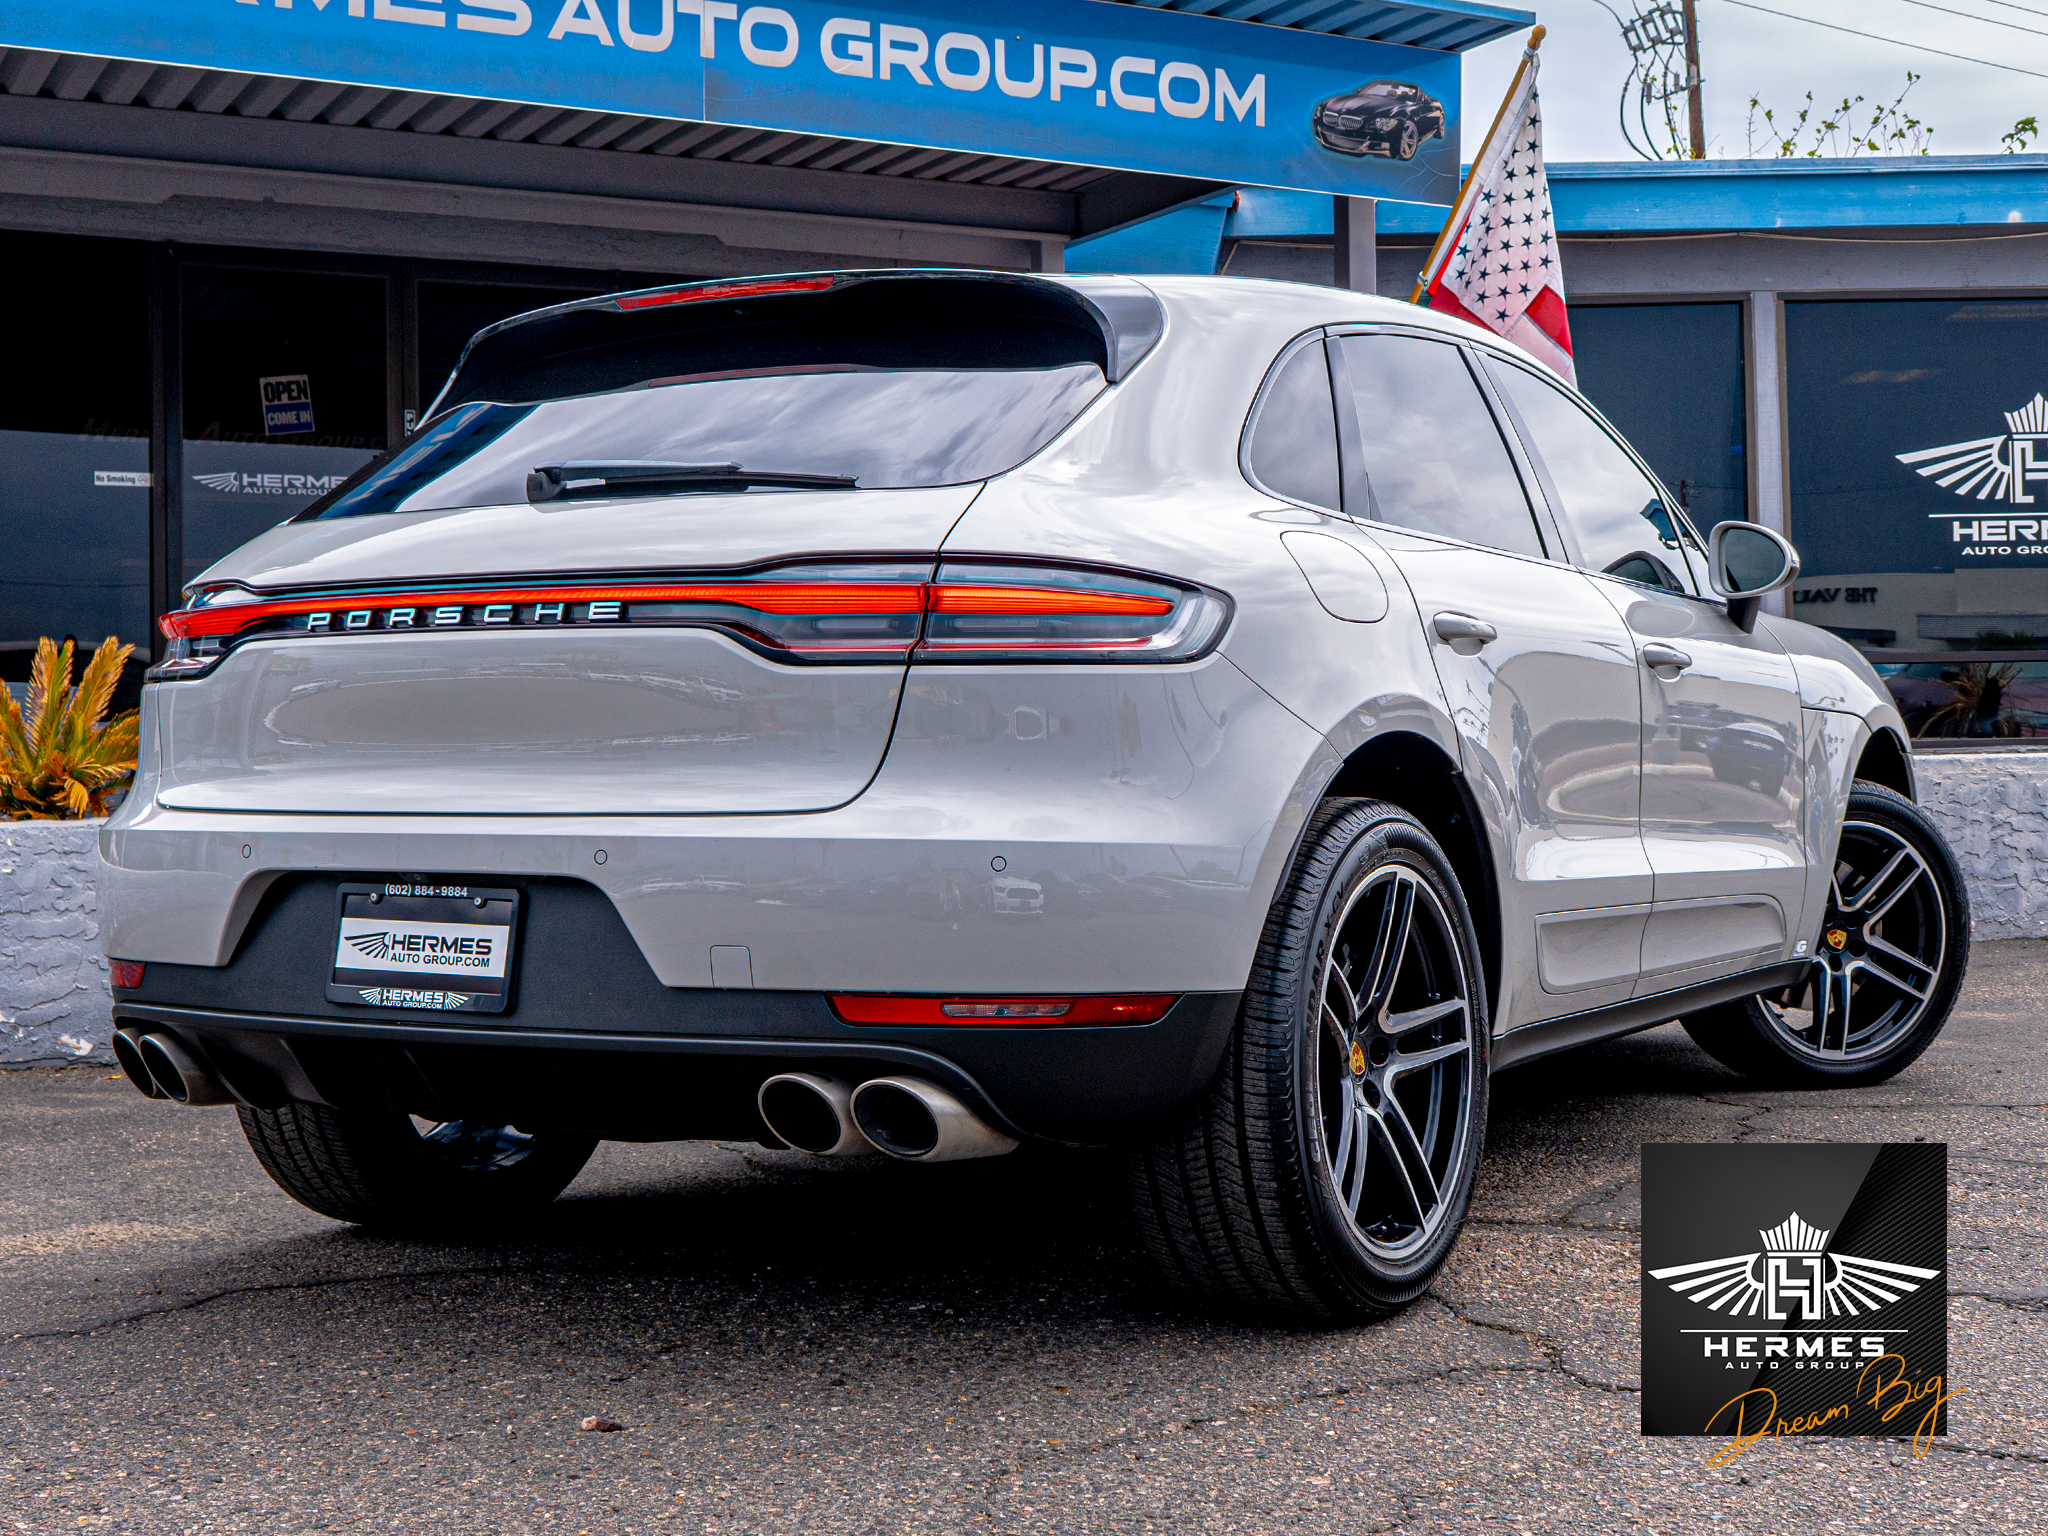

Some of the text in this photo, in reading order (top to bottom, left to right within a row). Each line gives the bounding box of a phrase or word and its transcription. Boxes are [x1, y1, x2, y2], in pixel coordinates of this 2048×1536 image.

[547, 0, 800, 68] AUTO
[819, 17, 1267, 127] GROUP.COM
[263, 379, 309, 403] OPEN
[267, 409, 312, 426] COME IN
[95, 474, 136, 485] No Smoking
[242, 473, 349, 489] HERME
[242, 487, 332, 497] AUTO GROU
[1952, 519, 2048, 542] HER
[1961, 546, 2012, 556] AUTO
[307, 601, 622, 631] PORSCHE
[385, 883, 468, 897] (602) 884-9884
[390, 933, 493, 956] HERMES
[390, 952, 491, 968] AUTO GROUP.COM
[382, 989, 444, 1003] HERMES
[402, 1001, 443, 1009] GROUP.COM
